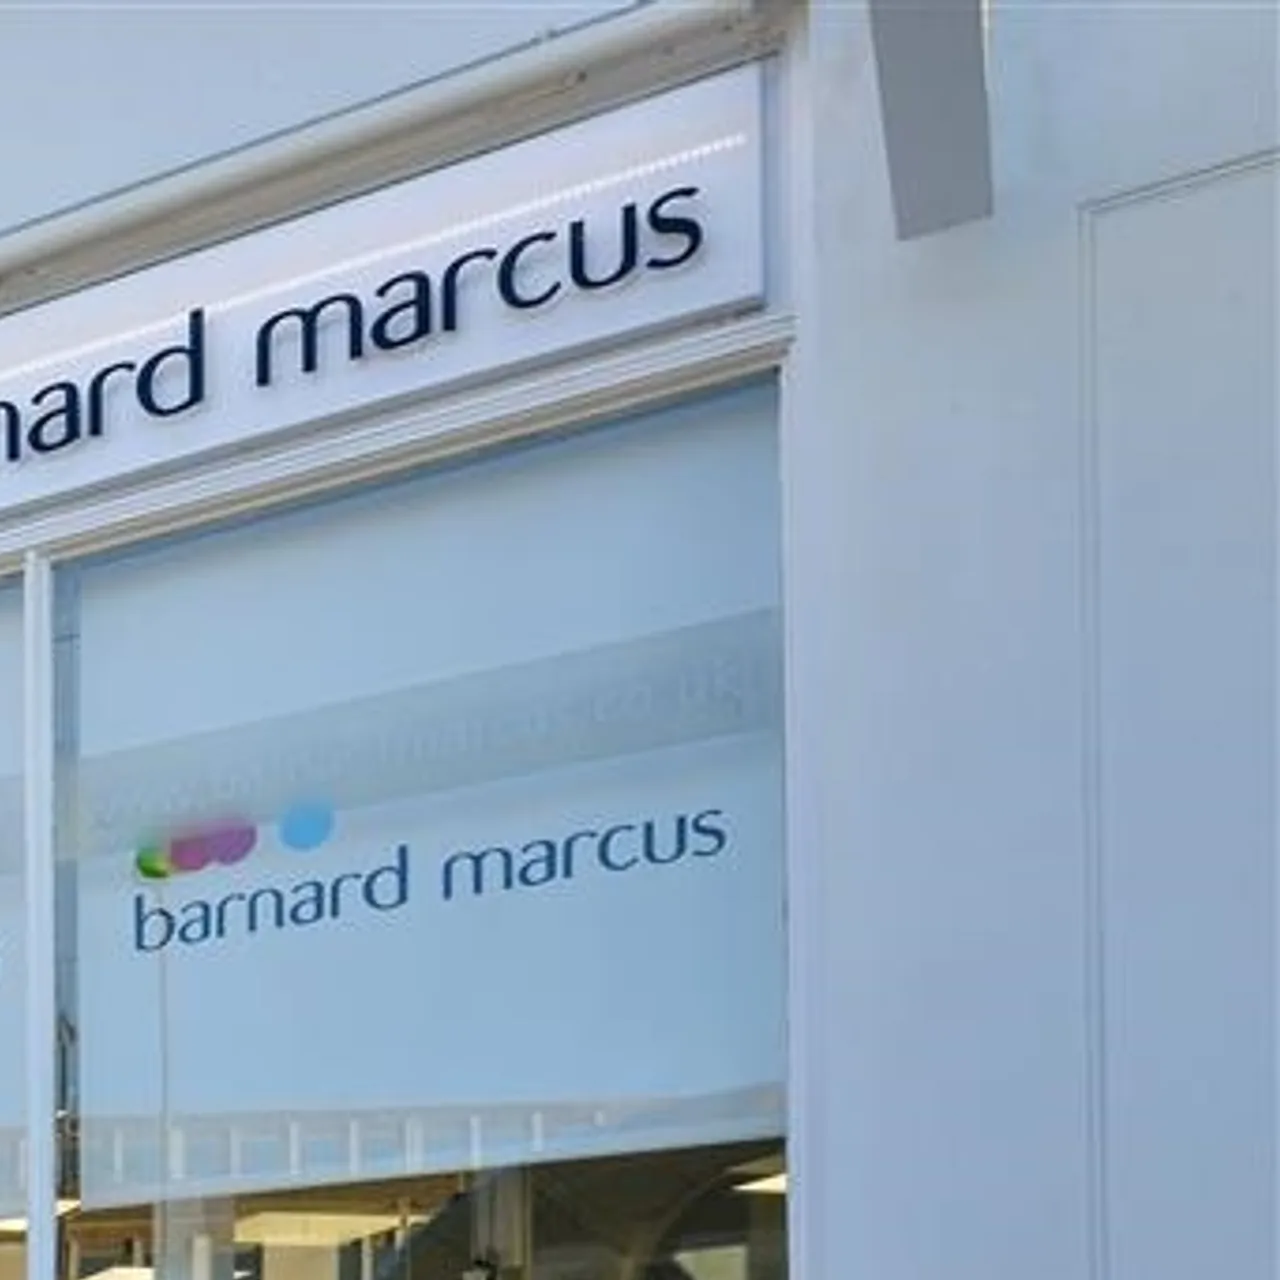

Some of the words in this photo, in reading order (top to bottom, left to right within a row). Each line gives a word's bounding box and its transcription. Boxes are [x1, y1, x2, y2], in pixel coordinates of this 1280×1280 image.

[254, 186, 704, 388] marcus
[134, 844, 412, 953] barnard
[441, 804, 729, 903] marcus
